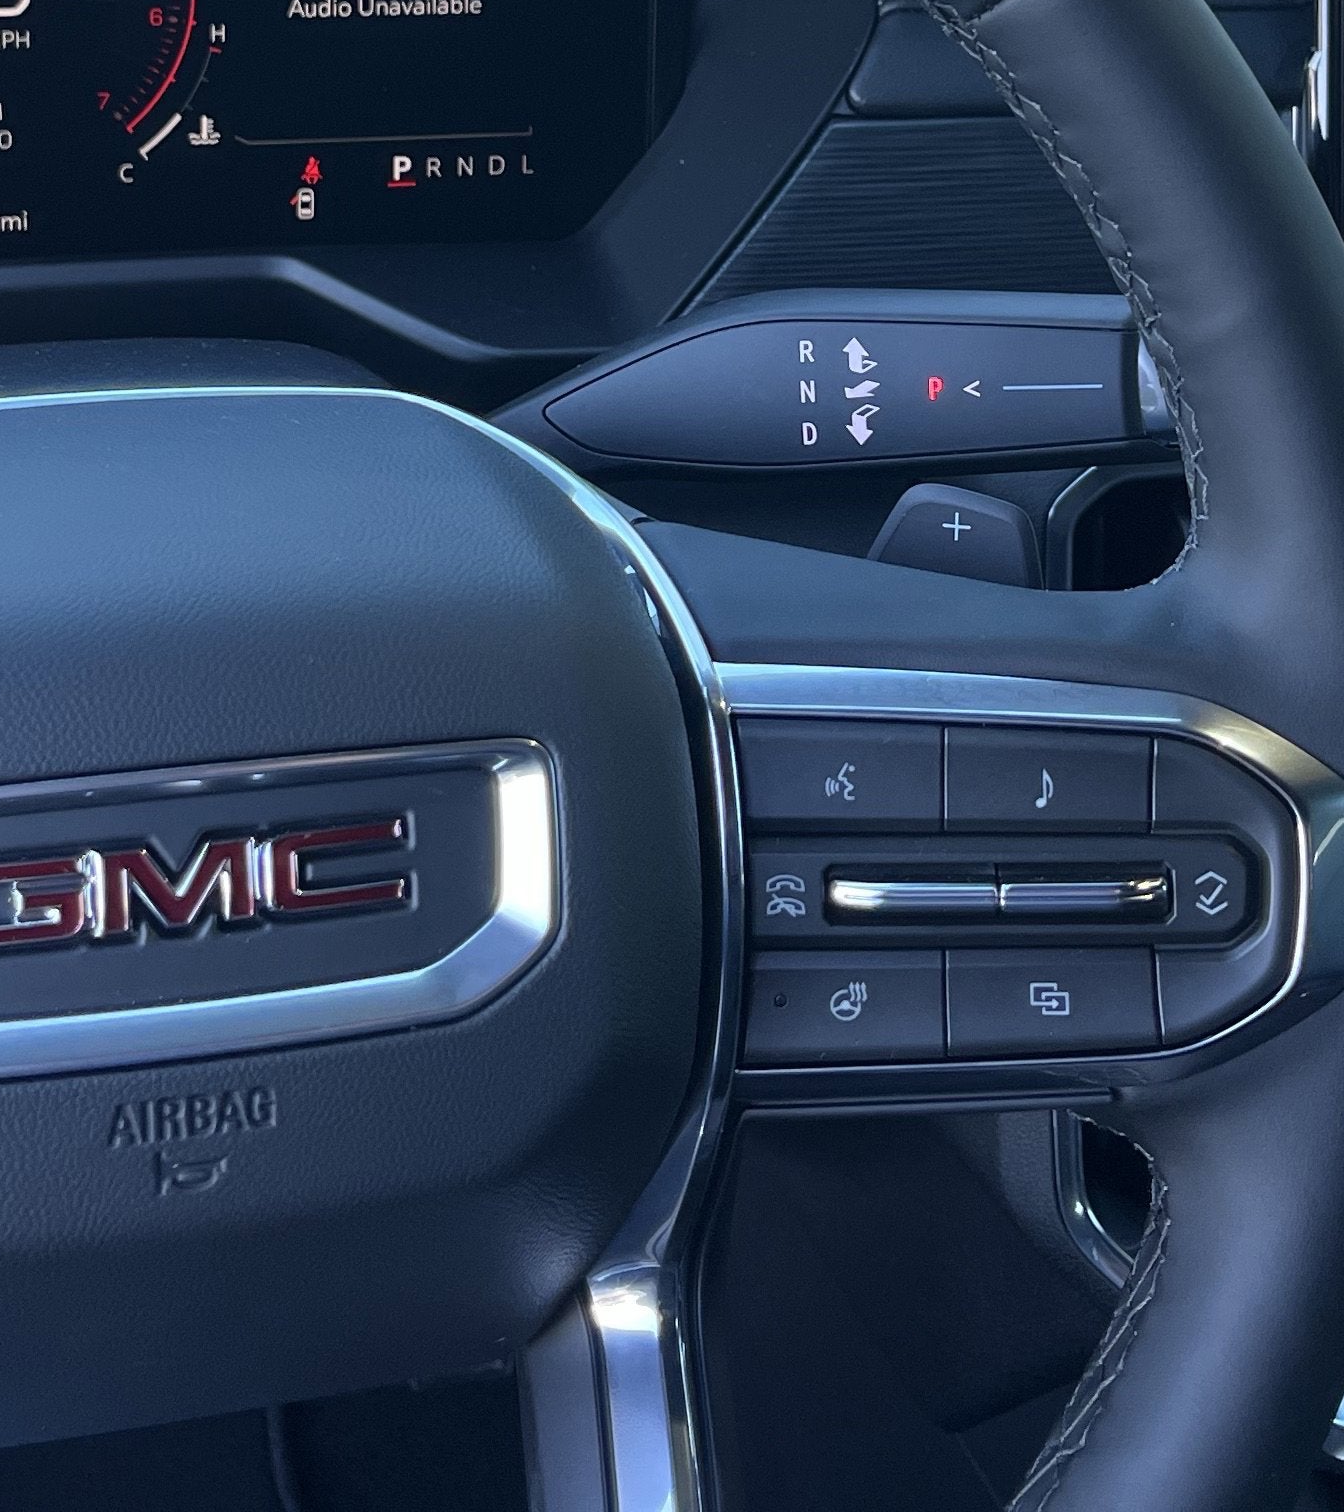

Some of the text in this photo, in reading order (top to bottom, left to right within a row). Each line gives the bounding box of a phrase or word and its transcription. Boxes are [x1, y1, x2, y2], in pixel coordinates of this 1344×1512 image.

[148, 7, 163, 26] 6
[209, 24, 227, 43] H
[118, 163, 135, 184] C
[392, 154, 535, 181] P R N D L
[799, 340, 815, 363] R
[800, 380, 816, 403] N
[928, 376, 944, 401] P
[802, 422, 818, 446] D
[108, 1089, 277, 1149] AIRBAG
